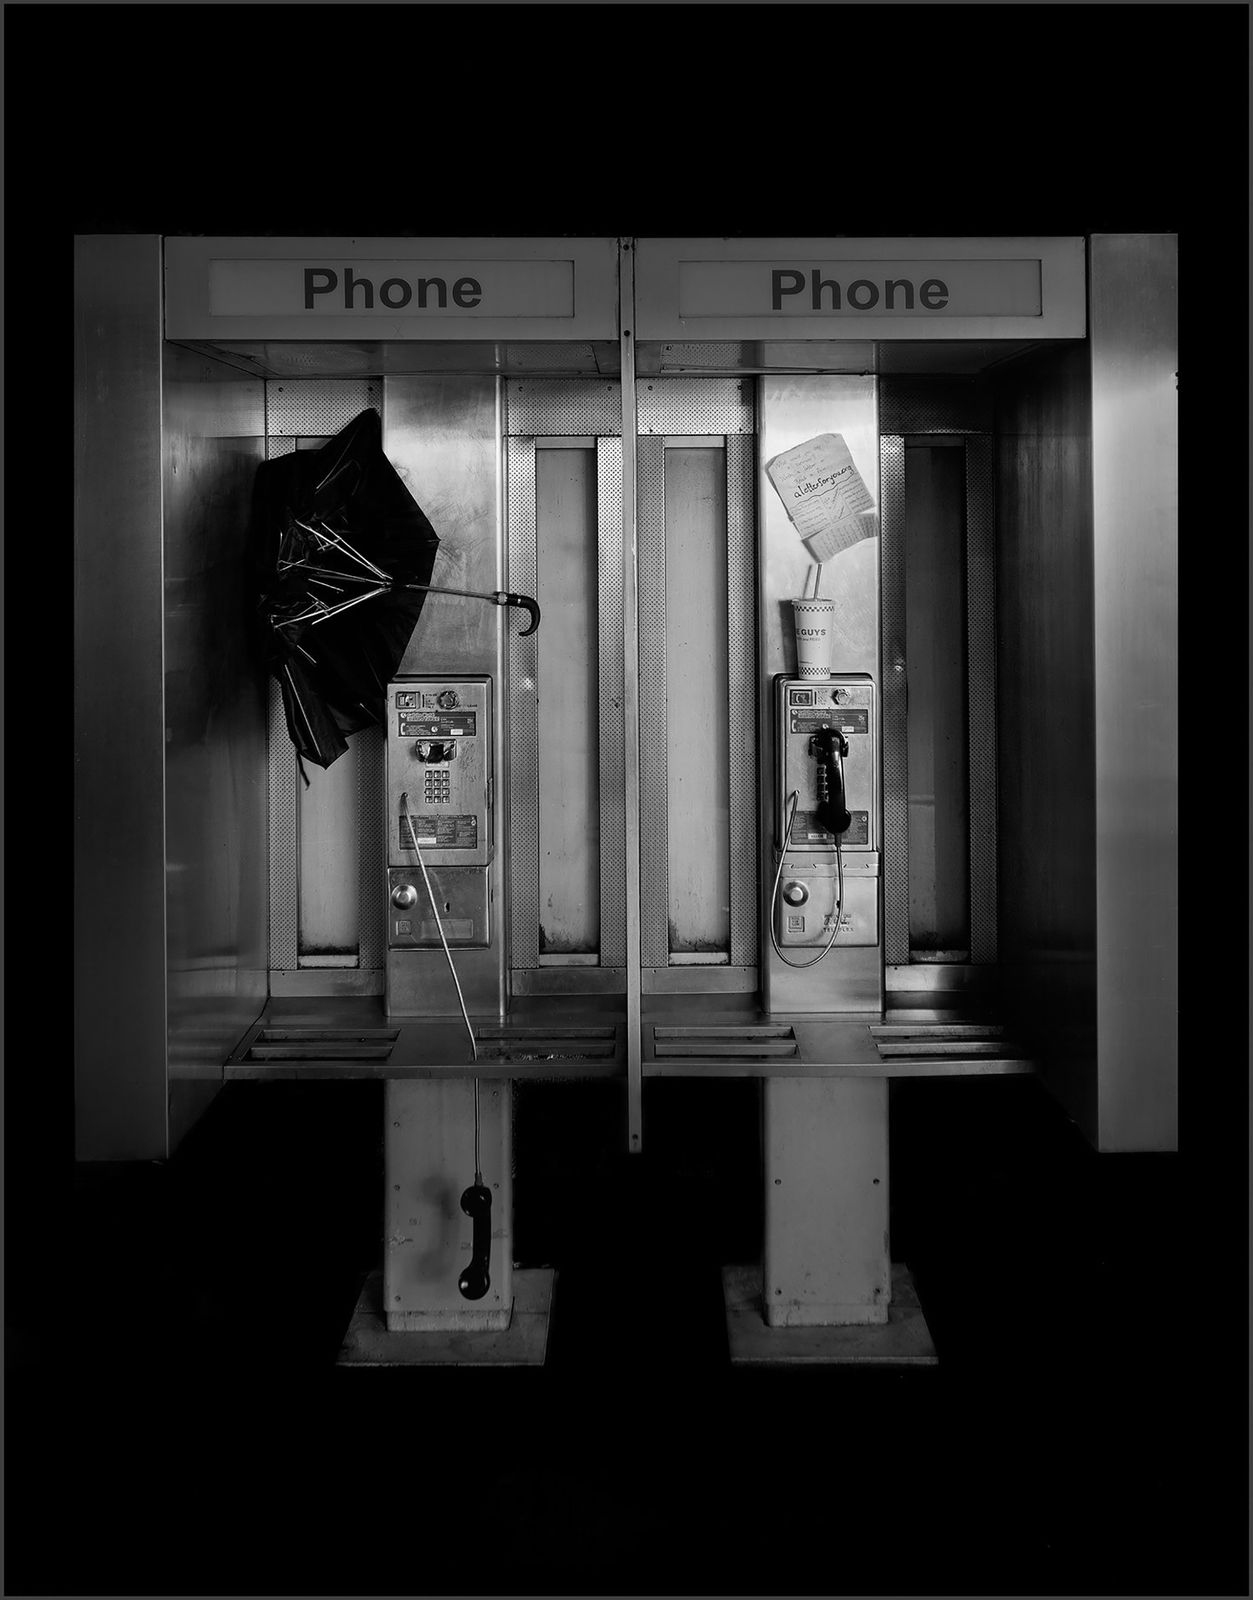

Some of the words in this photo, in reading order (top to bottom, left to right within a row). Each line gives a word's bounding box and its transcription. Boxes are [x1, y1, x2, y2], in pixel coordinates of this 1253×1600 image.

[304, 267, 482, 310] Phone
[771, 269, 949, 312] Phone
[801, 628, 826, 636] GUYS
